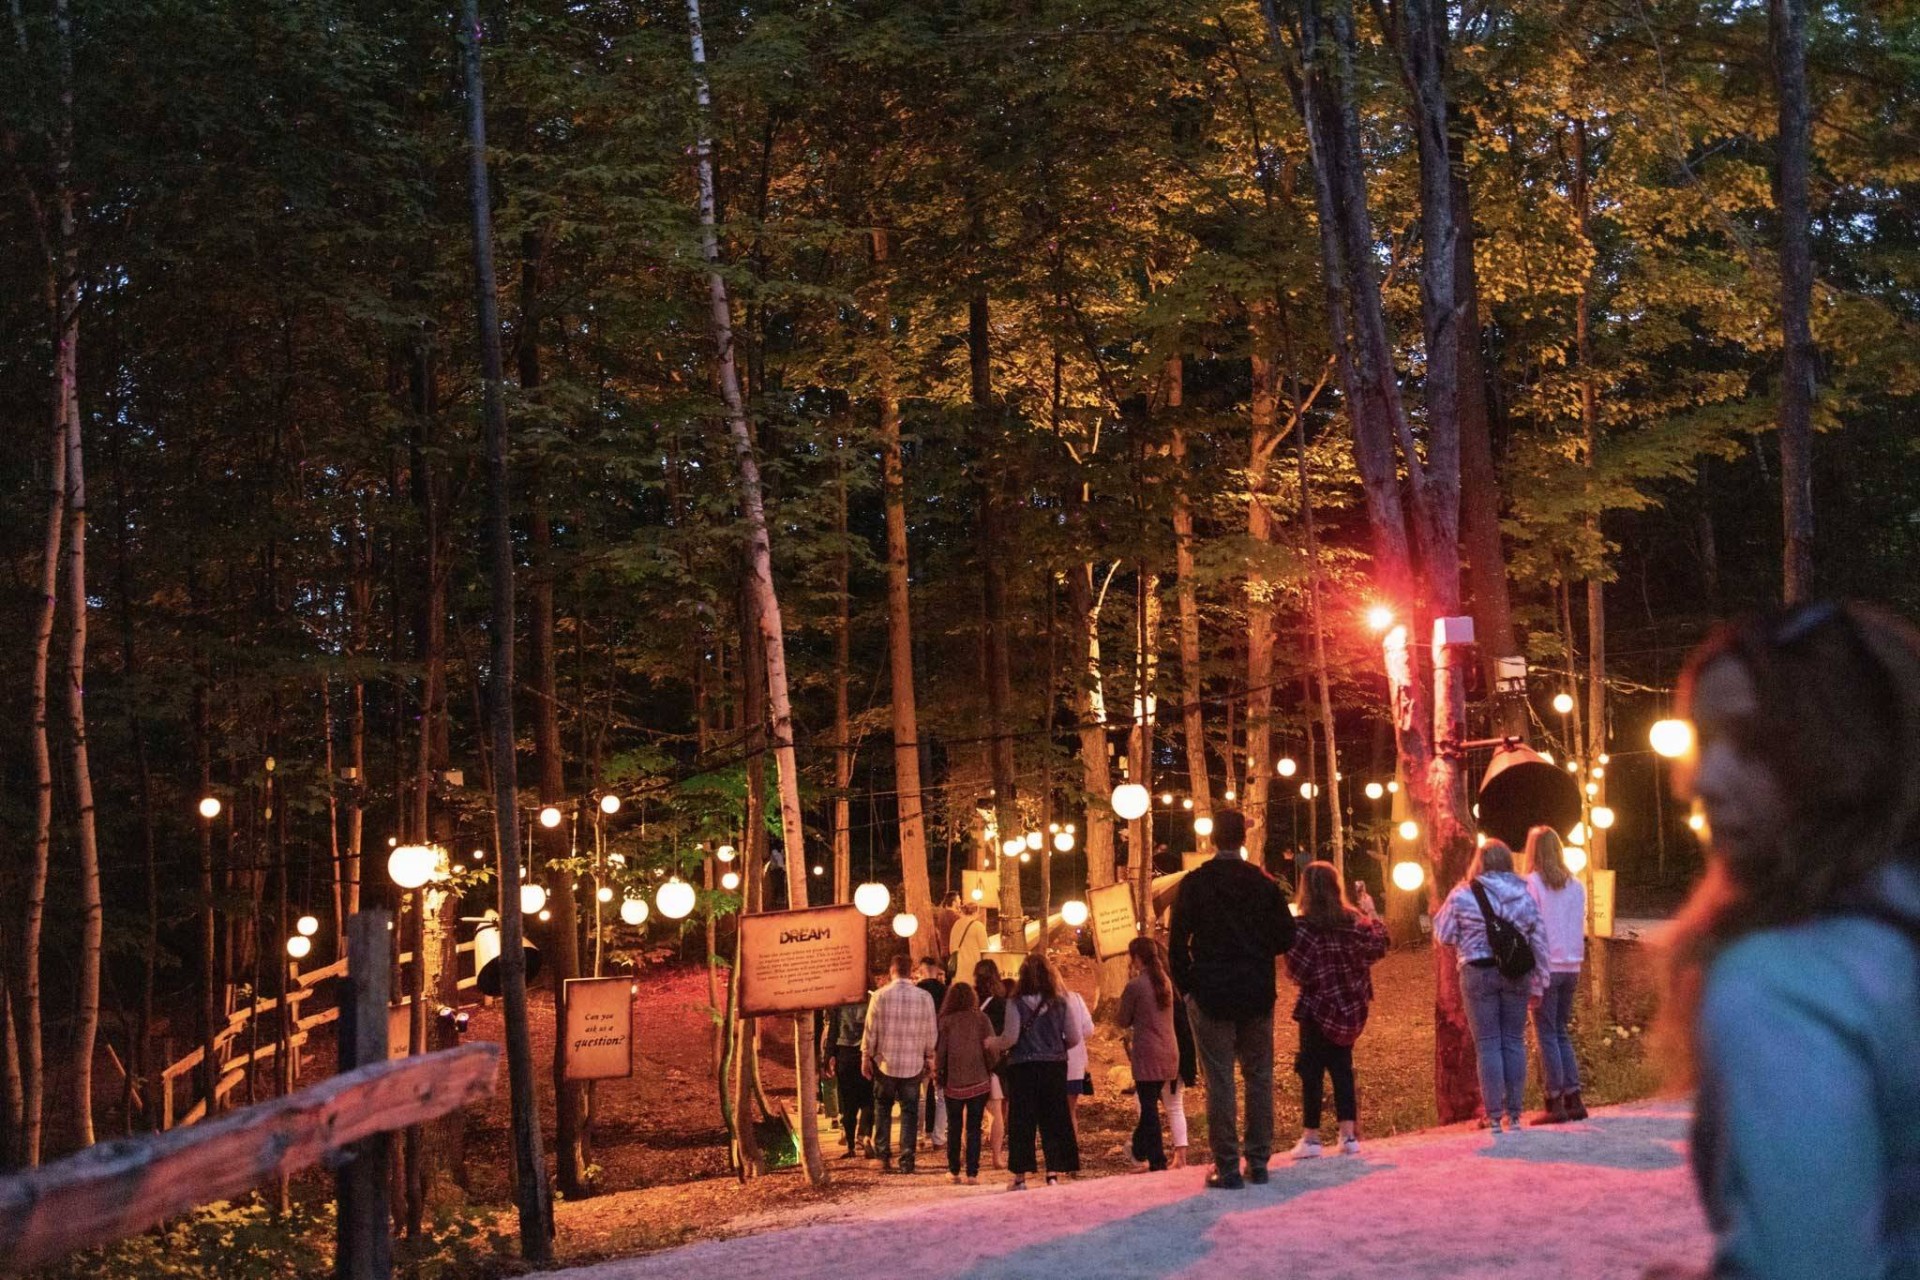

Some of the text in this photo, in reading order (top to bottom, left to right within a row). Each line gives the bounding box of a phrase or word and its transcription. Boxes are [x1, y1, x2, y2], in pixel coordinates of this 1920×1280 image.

[780, 928, 831, 944] DREAM
[601, 1014, 614, 1022] you
[585, 1025, 597, 1033] ask
[574, 1034, 626, 1052] question?
